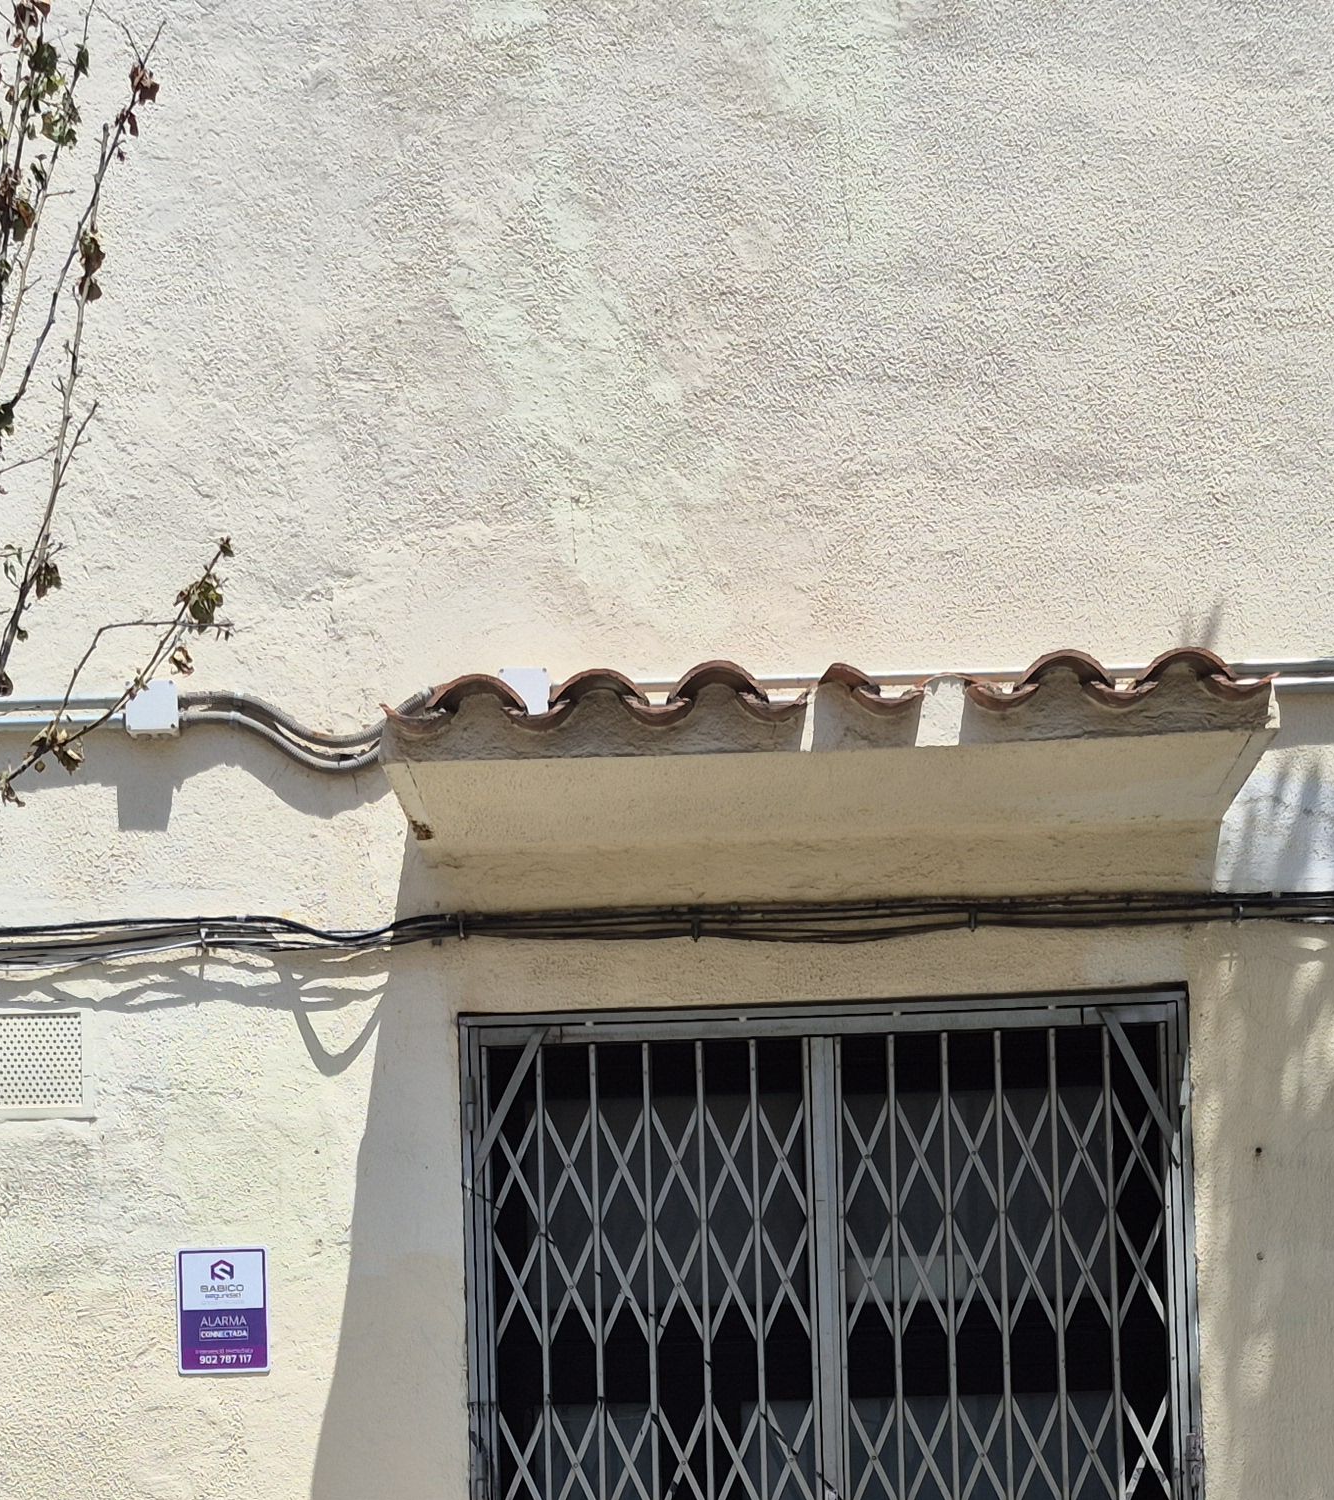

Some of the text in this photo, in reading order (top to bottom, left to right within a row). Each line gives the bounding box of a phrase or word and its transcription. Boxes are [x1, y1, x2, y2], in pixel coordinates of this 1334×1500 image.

[200, 1284, 244, 1293] SABICO
[200, 1316, 247, 1327] ALARMA
[200, 1330, 247, 1338] CONNECTADA
[199, 1354, 252, 1365] 902 787 117
